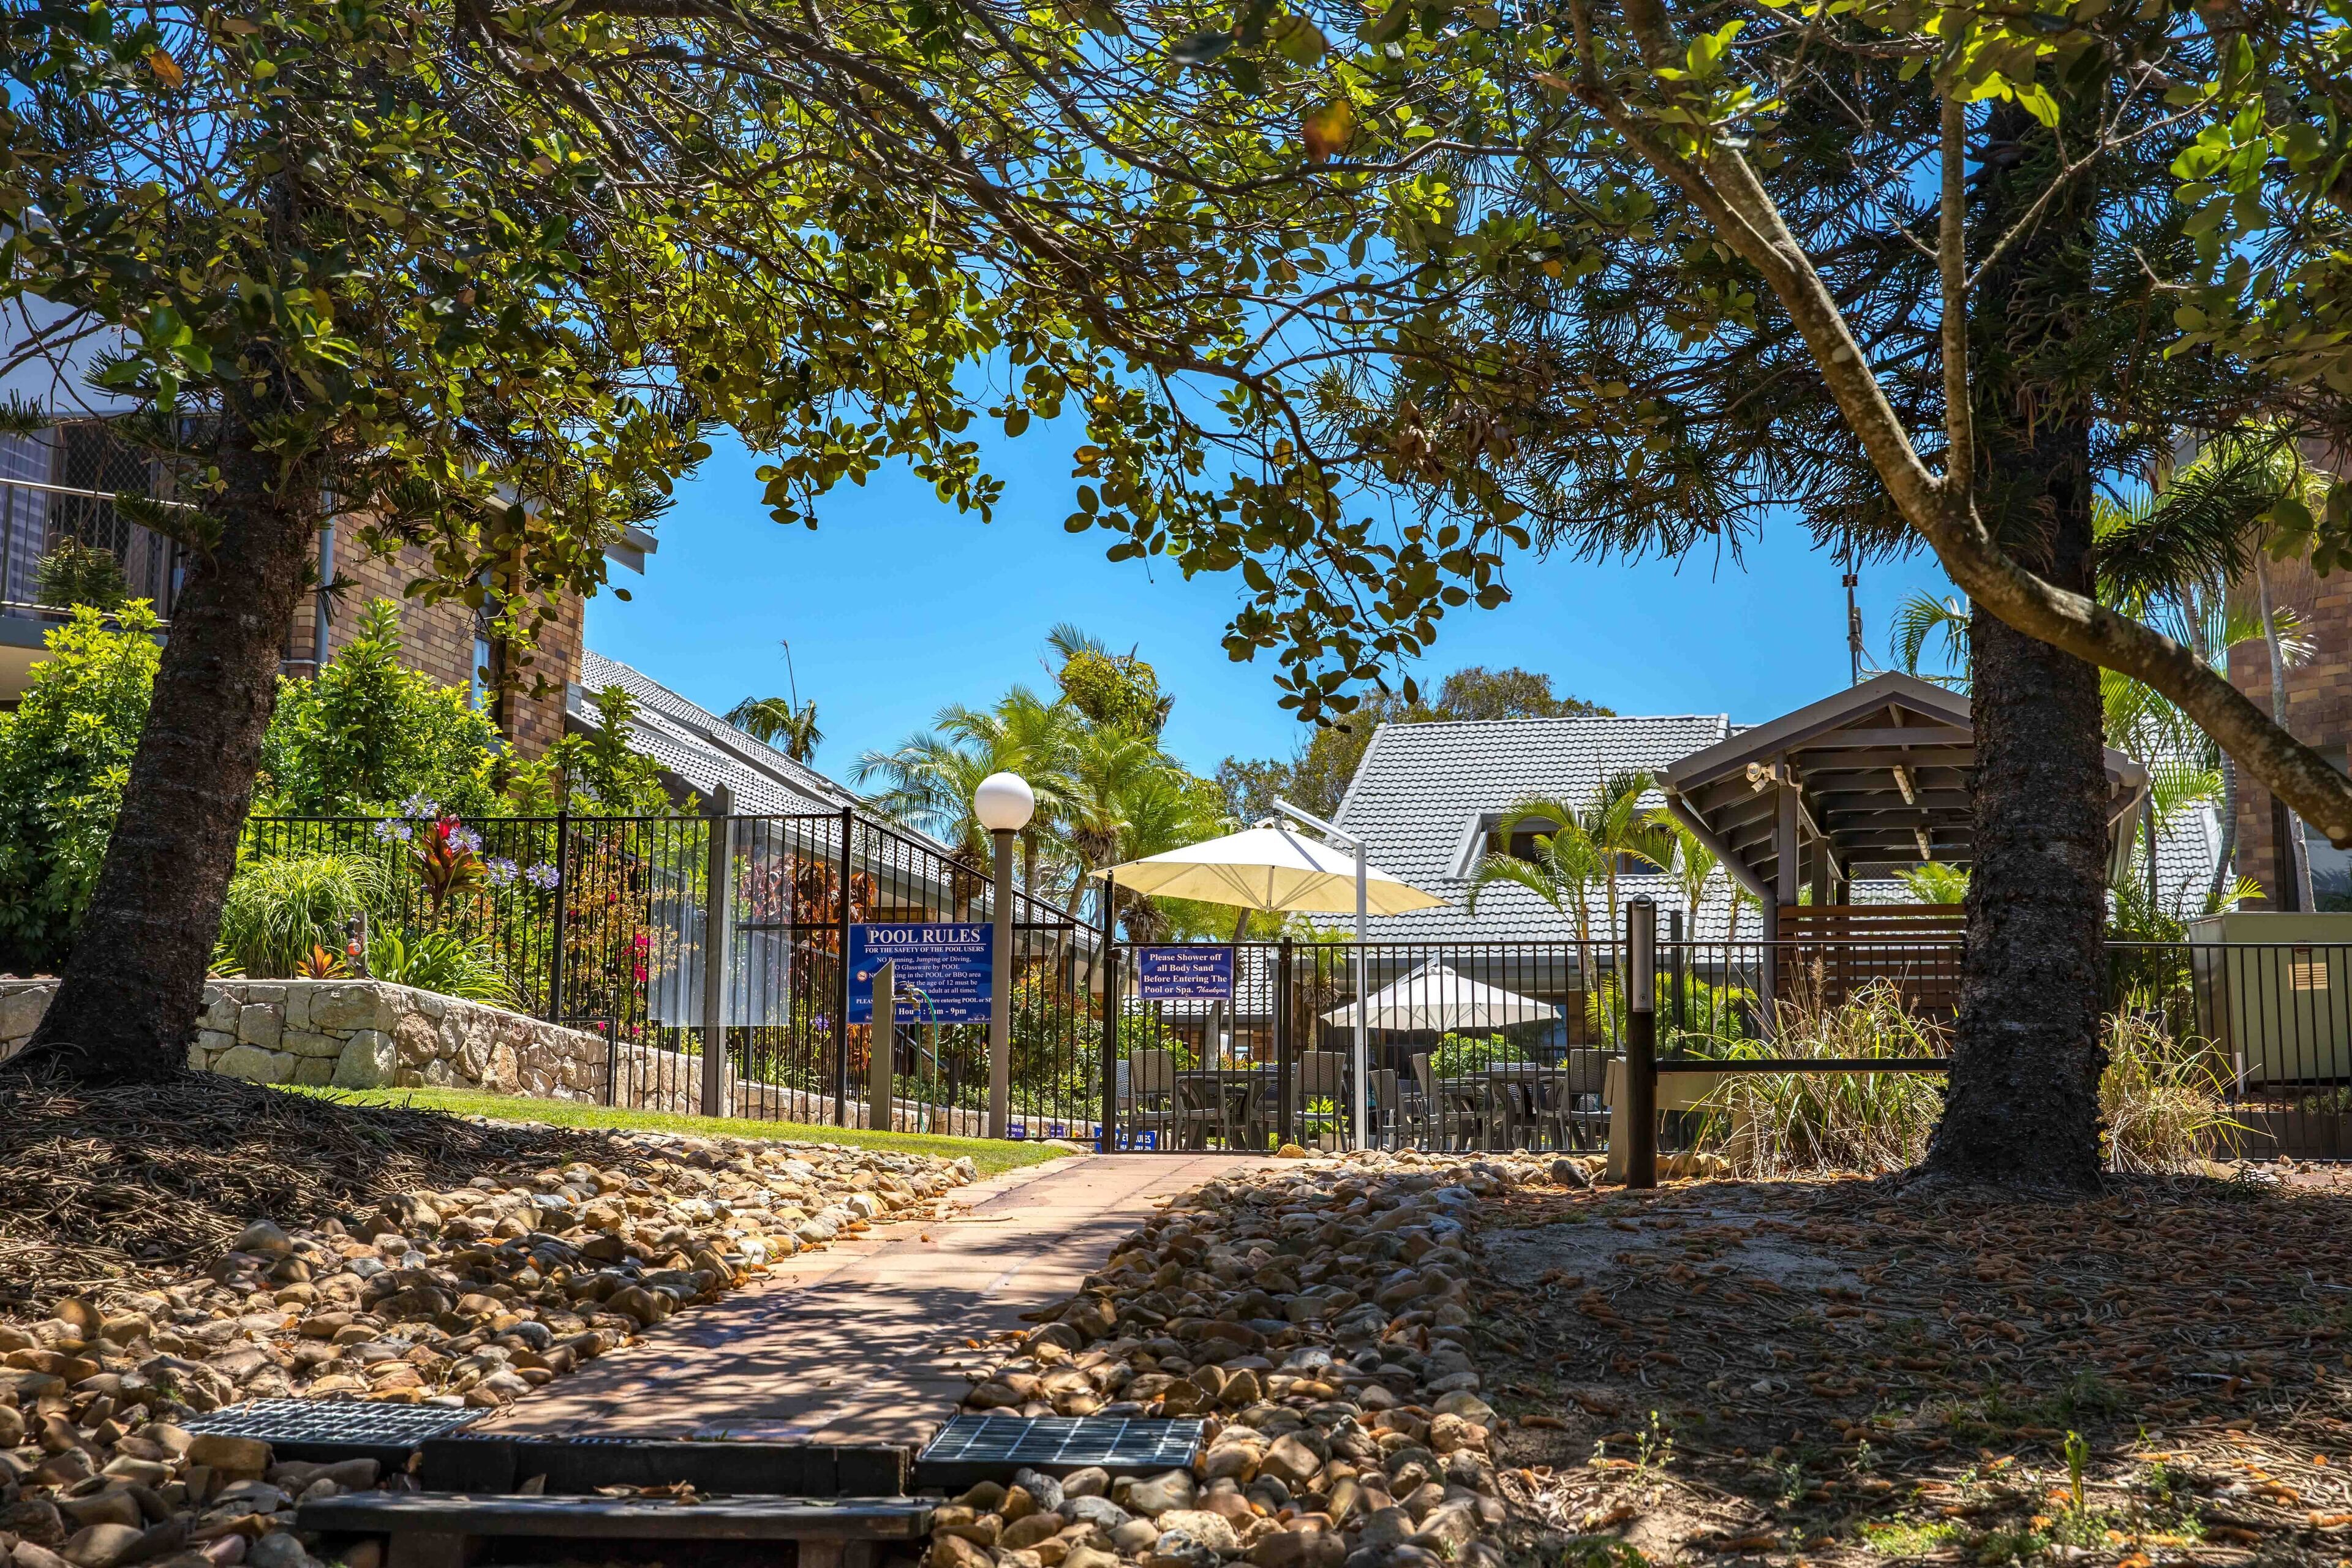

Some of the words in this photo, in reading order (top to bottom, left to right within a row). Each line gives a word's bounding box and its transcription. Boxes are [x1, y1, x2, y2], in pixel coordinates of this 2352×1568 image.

[869, 930, 918, 943] POOL
[922, 929, 980, 943] RULES
[1169, 964, 1191, 973] Body
[1173, 975, 1208, 984] Entering
[1175, 986, 1194, 995] Spa.
[1196, 986, 1227, 995] Thankyou
[951, 1008, 967, 1016] 9pm
